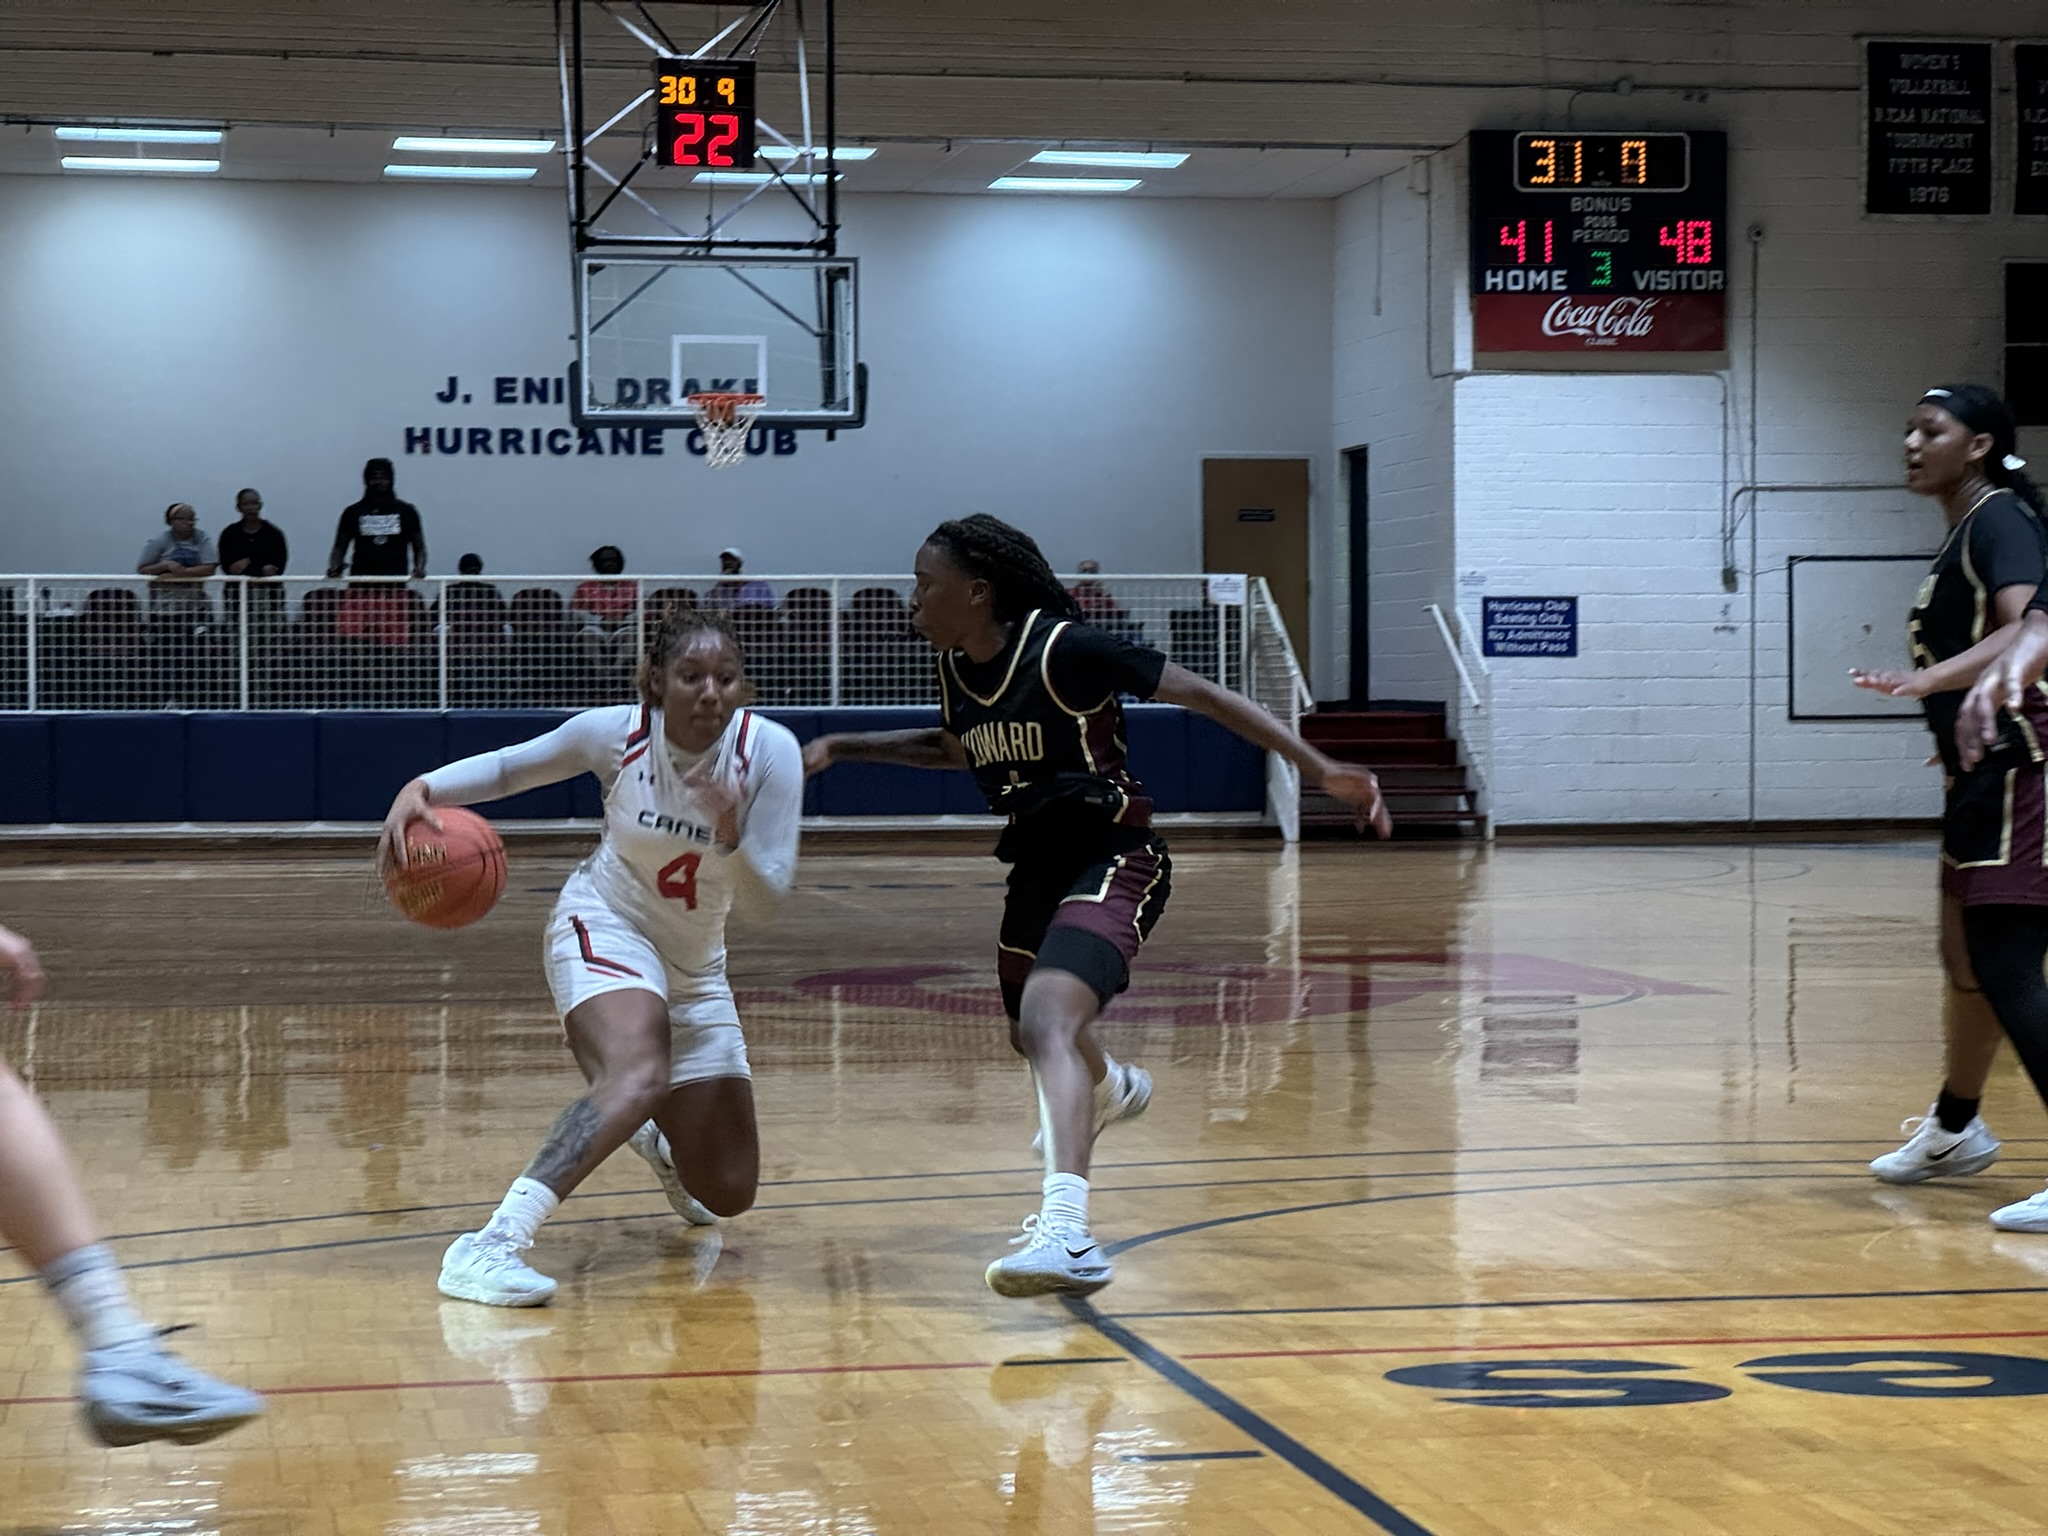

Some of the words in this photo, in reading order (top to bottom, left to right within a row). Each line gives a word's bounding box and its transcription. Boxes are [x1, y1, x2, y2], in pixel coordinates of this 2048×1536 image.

[1889, 78, 1971, 95] VOLLEYBALL
[1920, 108, 1985, 124] NATIONAL
[673, 113, 739, 166] 22
[1886, 132, 1974, 148] TOURNAMENT
[1931, 158, 1974, 174] PLACE
[1570, 197, 1632, 212] BONUS
[1583, 215, 1617, 228] POSS
[1500, 220, 1553, 263] 41
[1572, 229, 1630, 243] PERIOD
[1659, 220, 1712, 263] 48
[1591, 250, 1612, 286] 3
[1485, 269, 1568, 291] HOME
[1632, 269, 1725, 291] VISITOR
[1541, 295, 1661, 337] Coca-Cola
[436, 377, 472, 404] J.
[494, 377, 564, 404] ENI
[404, 426, 664, 456] HURRICANE
[686, 426, 799, 456] CUB
[1487, 600, 1543, 612] Hurricane
[1544, 600, 1571, 612] Club
[1493, 612, 1538, 625] Seating
[1539, 612, 1566, 625] Only
[1487, 630, 1505, 640] No
[1505, 630, 1572, 641] Admittance
[1493, 641, 1538, 653] Without
[1539, 641, 1569, 653] Pass
[657, 852, 703, 911] 4
